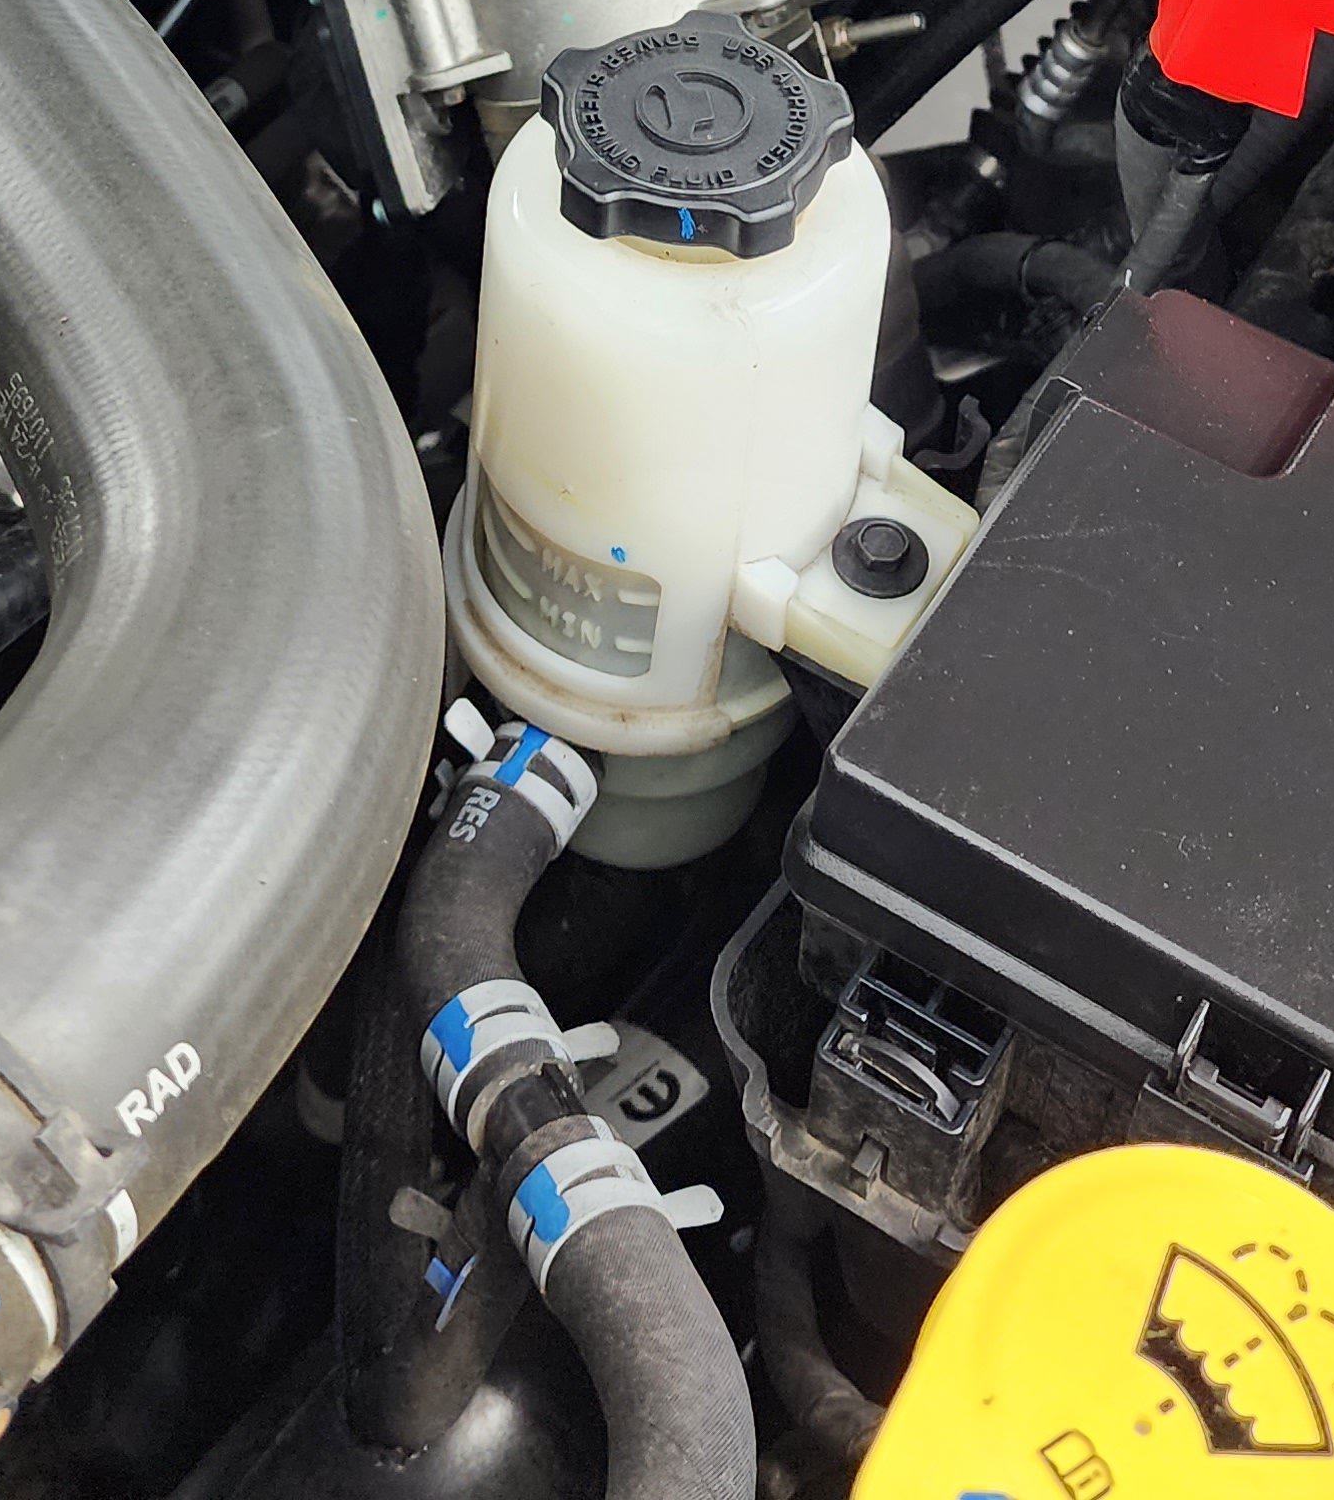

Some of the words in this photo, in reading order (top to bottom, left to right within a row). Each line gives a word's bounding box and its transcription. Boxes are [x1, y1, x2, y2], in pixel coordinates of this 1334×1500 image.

[600, 32, 700, 70] POWER
[576, 71, 642, 171] STEERING
[723, 37, 775, 71] USE
[756, 71, 809, 170] APPROVED
[649, 165, 738, 188] FLUID
[6, 371, 56, 461] 1107695
[541, 548, 603, 602] MAX
[539, 595, 602, 649] MIN
[449, 786, 501, 843] RES
[115, 1041, 204, 1137] RAD
